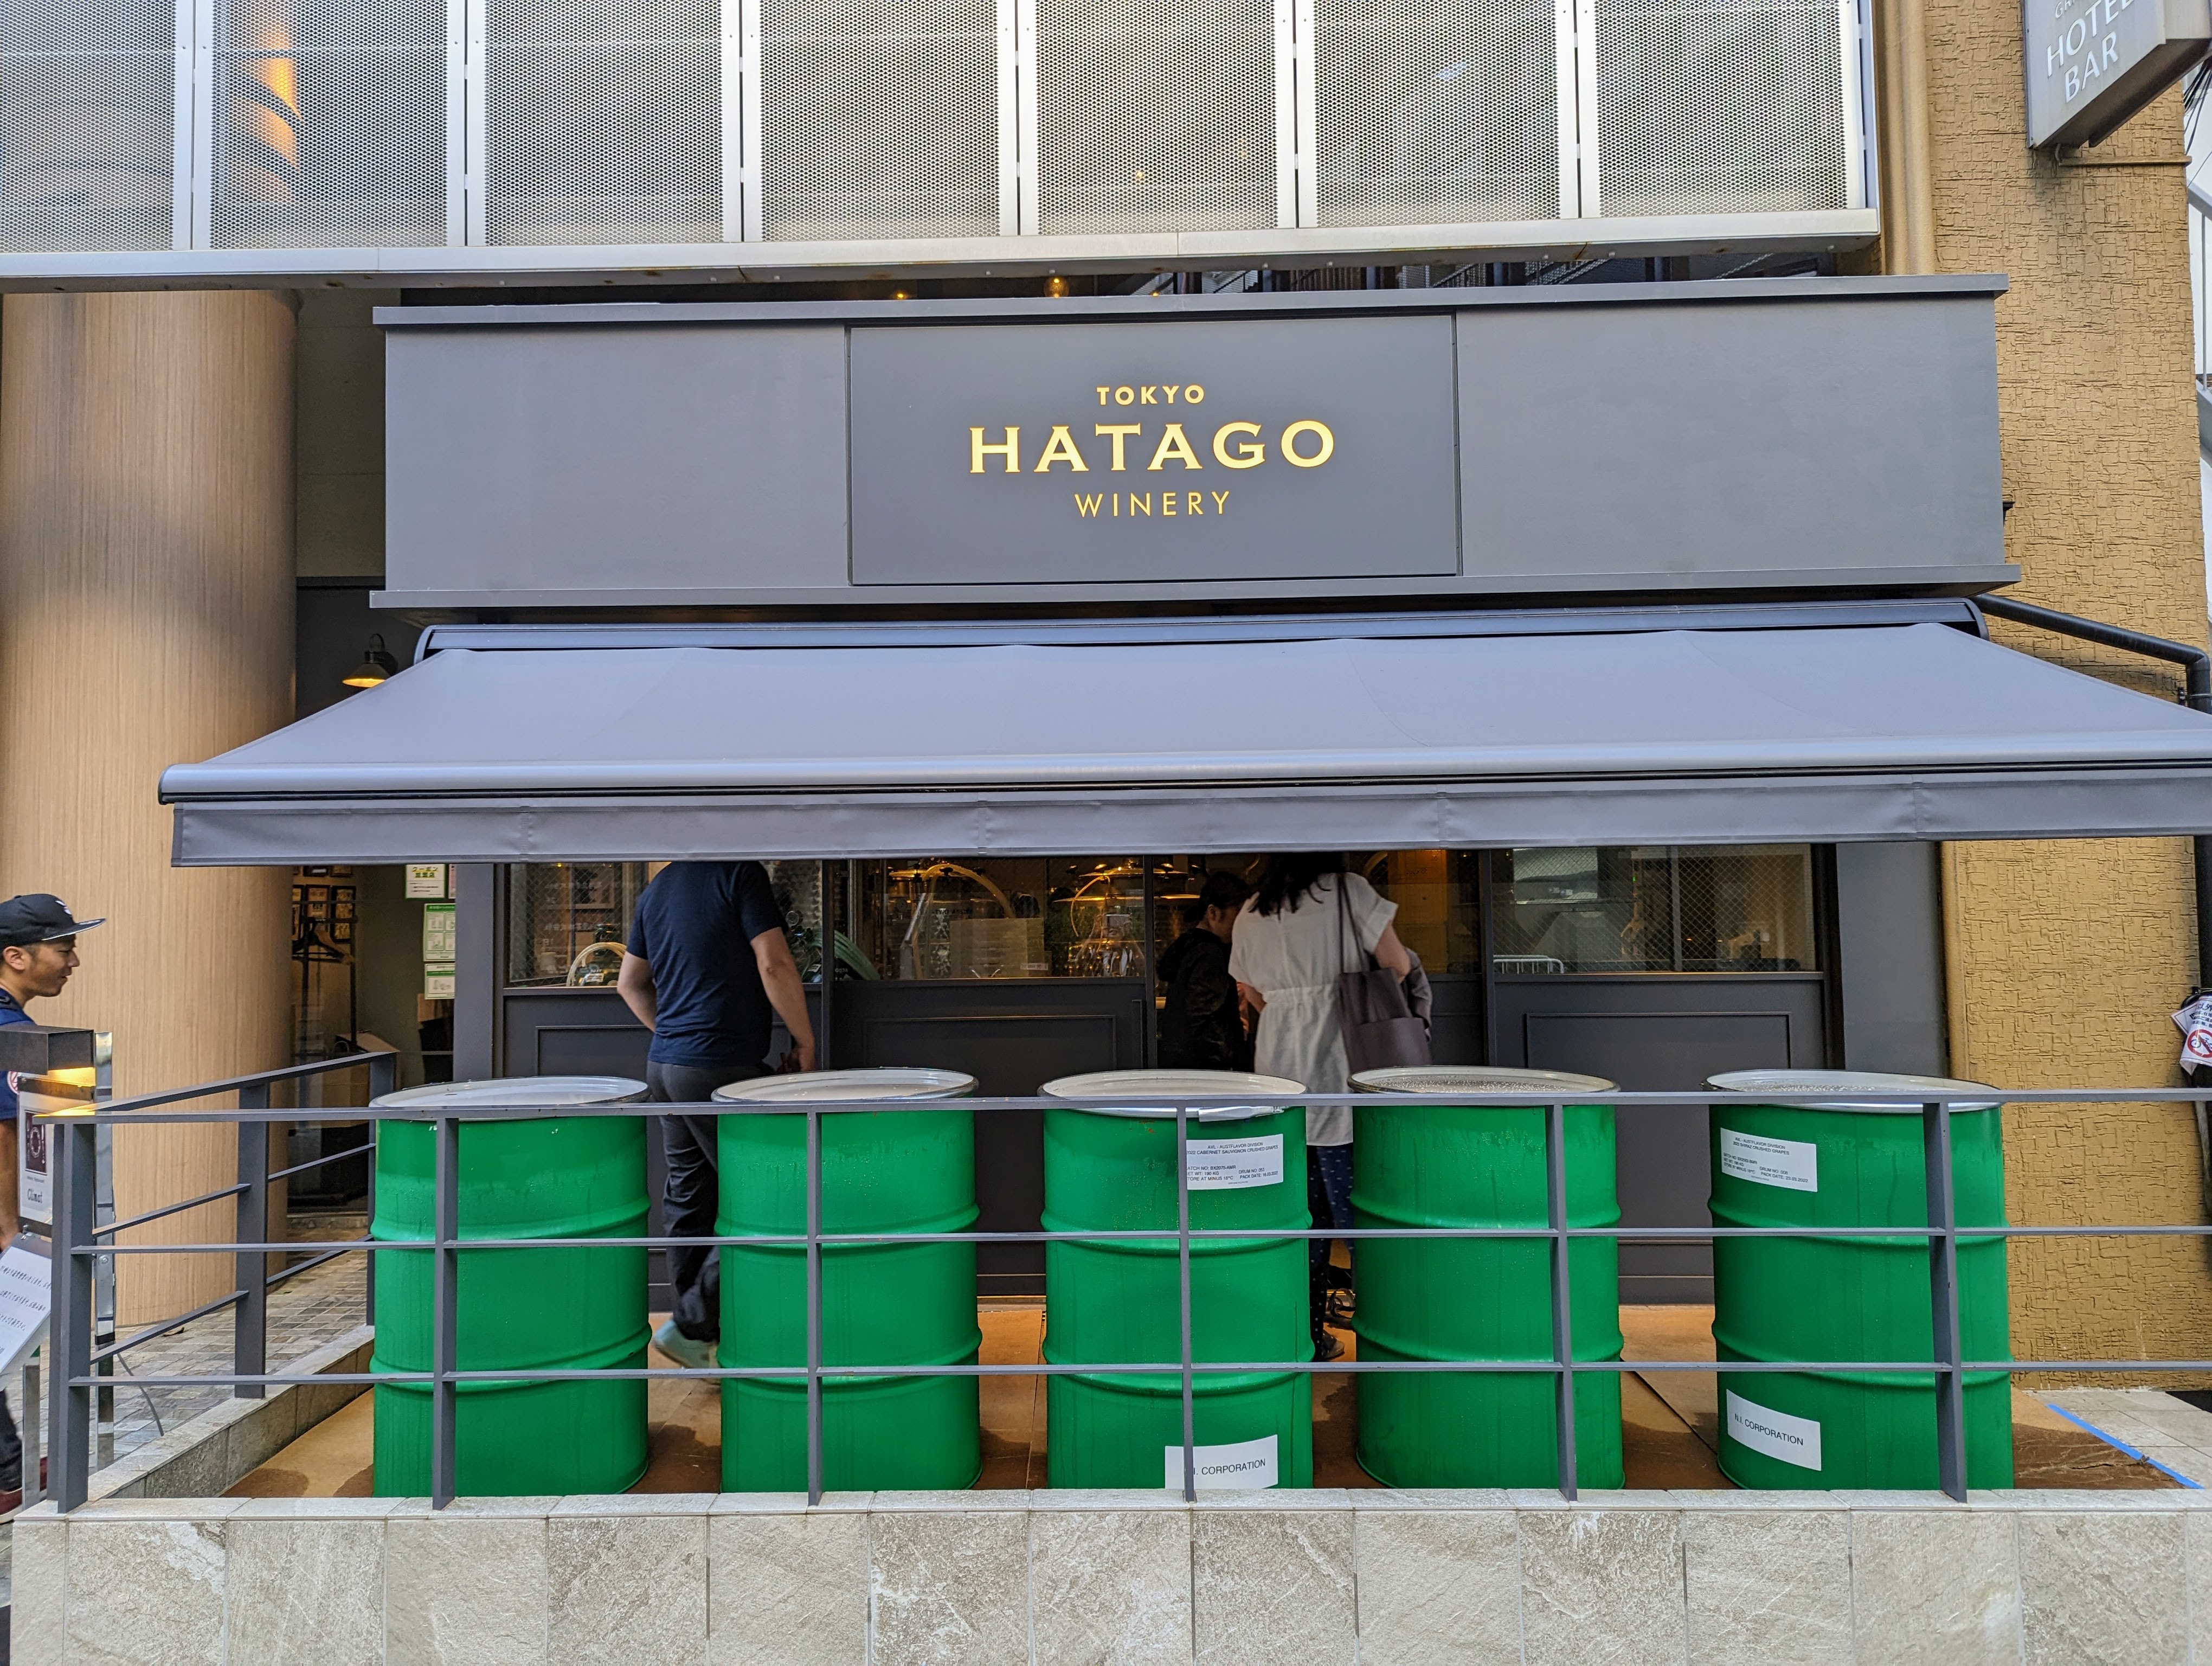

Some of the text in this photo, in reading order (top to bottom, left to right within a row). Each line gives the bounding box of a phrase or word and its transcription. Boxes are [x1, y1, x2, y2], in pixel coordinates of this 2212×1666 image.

[2065, 31, 2119, 102] BAR
[1097, 385, 1205, 405] TOKYO
[969, 420, 1335, 473] HATAGO
[1074, 490, 1230, 518] WINERY
[1734, 1413, 1804, 1446] N.I. CORPORATION
[1201, 1458, 1266, 1476] CORPORATION
